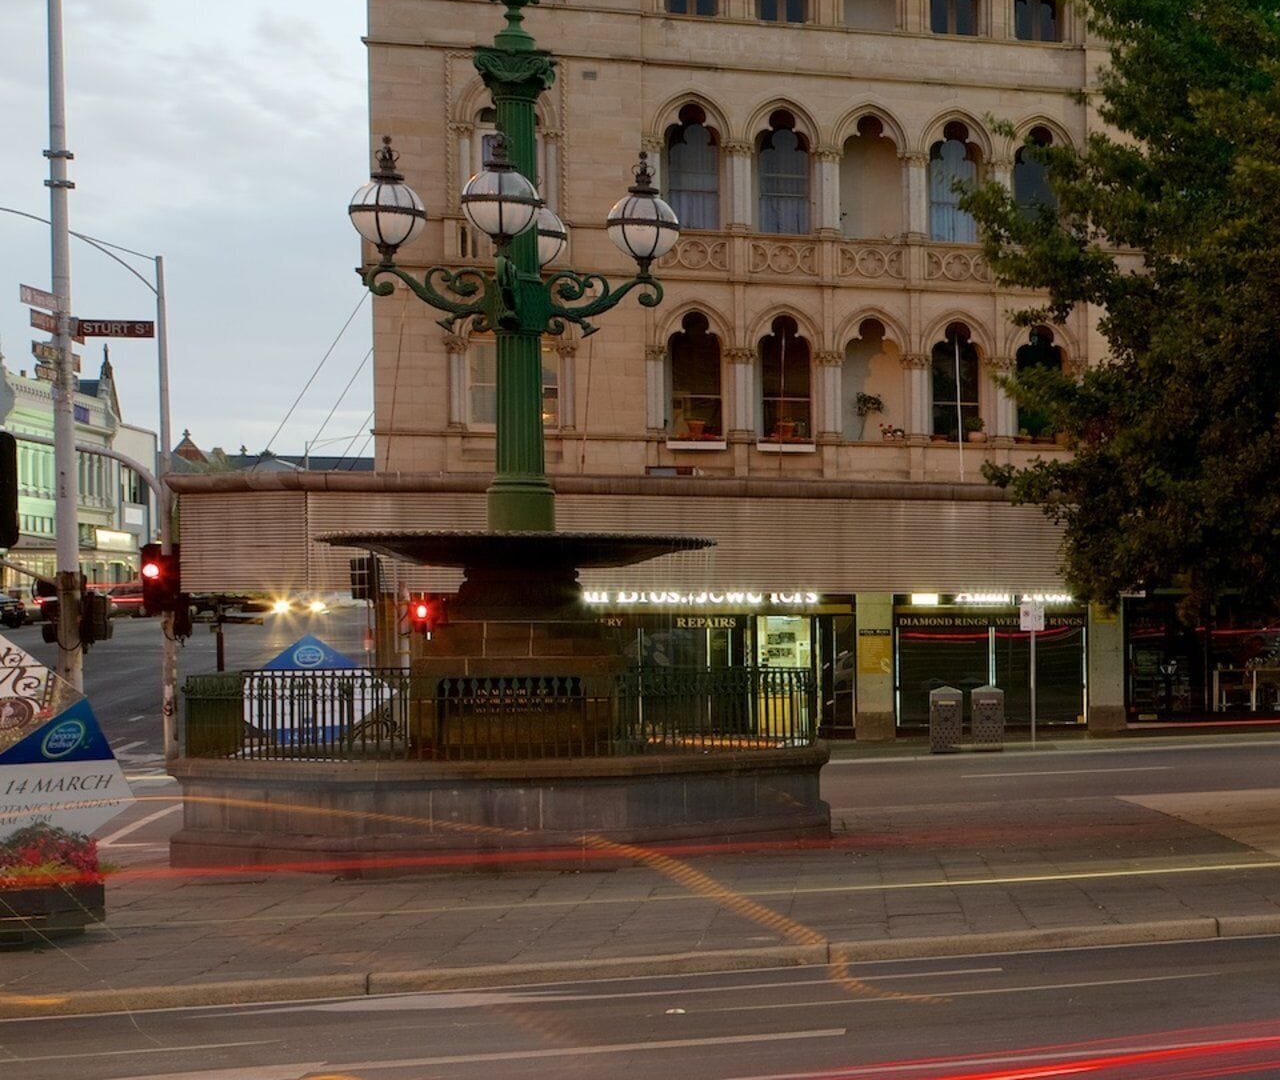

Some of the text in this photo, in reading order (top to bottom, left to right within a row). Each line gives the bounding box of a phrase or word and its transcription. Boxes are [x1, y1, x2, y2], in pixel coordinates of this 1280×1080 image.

[83, 322, 129, 334] STURT
[676, 617, 736, 628] REPAIRS
[900, 616, 952, 626] DIAMOND
[955, 616, 988, 626] RINGS
[1050, 616, 1083, 626] RINGS
[5, 775, 113, 794] 14 MARCH
